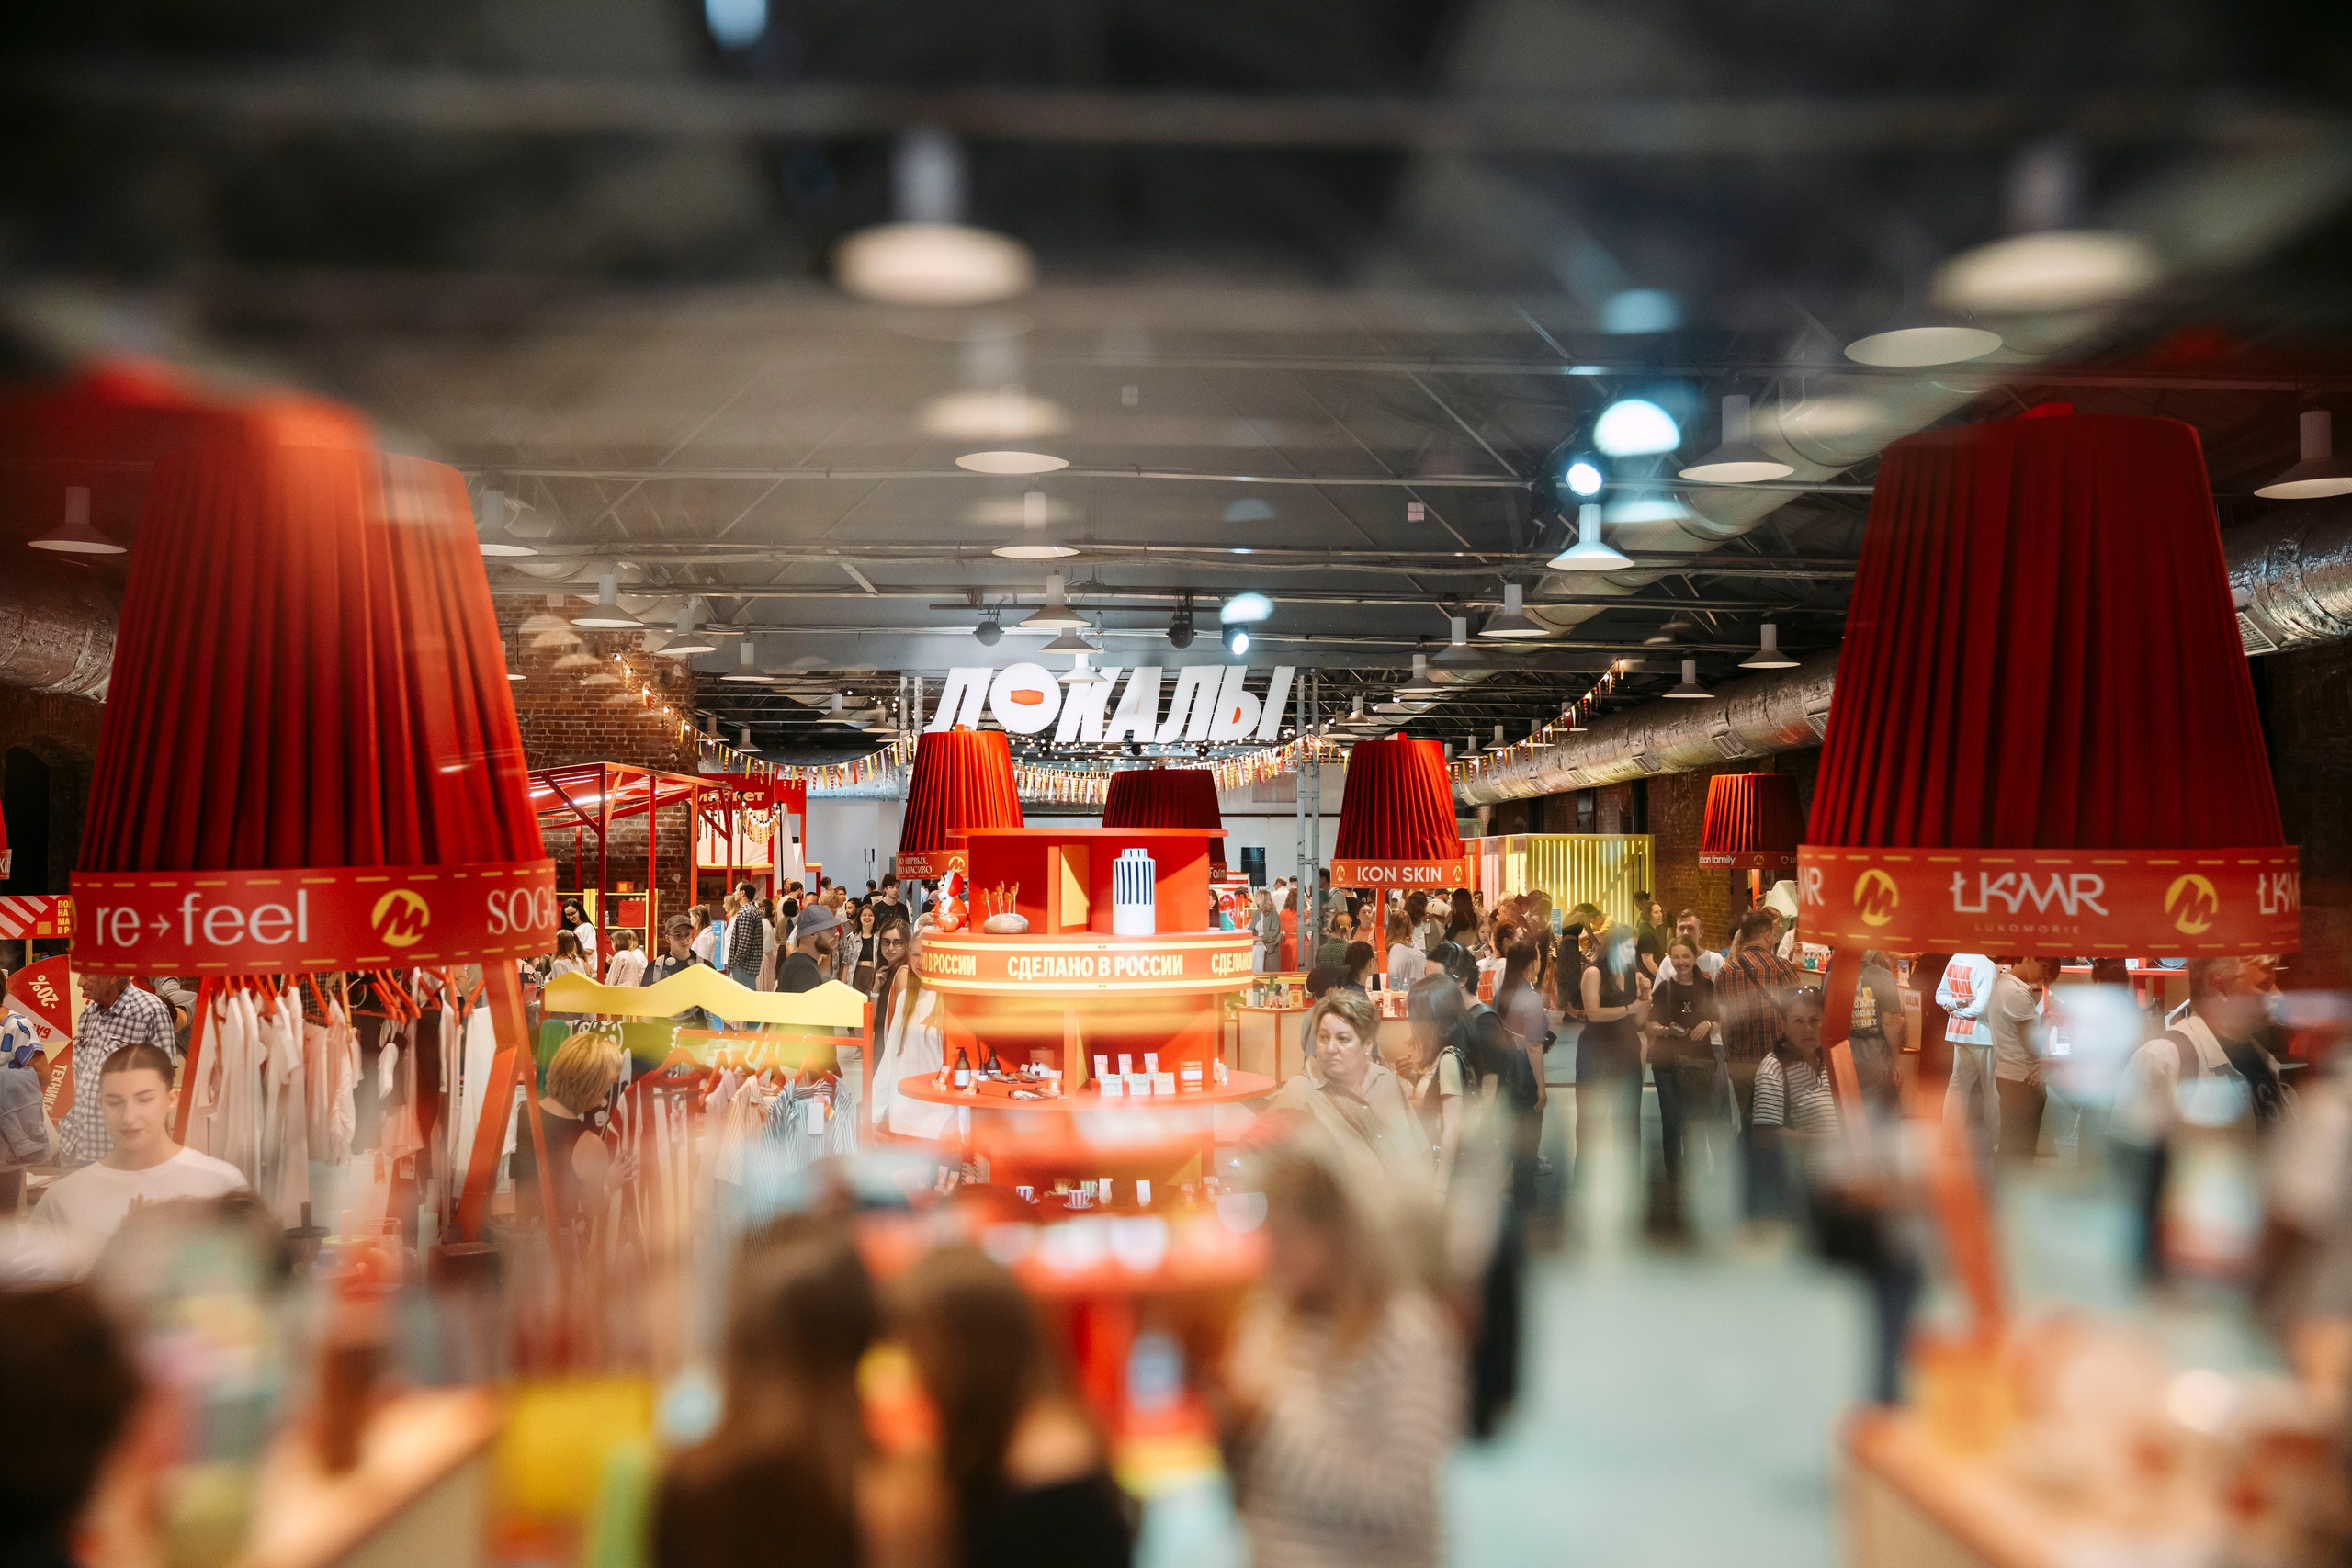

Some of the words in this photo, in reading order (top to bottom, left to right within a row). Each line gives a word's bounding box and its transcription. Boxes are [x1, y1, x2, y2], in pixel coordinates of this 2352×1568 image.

[924, 662, 1295, 743] ЛОКАЛЫ
[1712, 855, 1736, 865] family
[1357, 866, 1396, 882] ICON
[1402, 866, 1442, 883] SKIN
[177, 889, 307, 946] feel
[1974, 922, 2080, 934] LUKOMORIE
[933, 953, 977, 976] РОССИИ
[1007, 955, 1093, 980] СДЕЛАНО
[1098, 956, 1110, 976] В
[1114, 955, 1183, 976] РОССИИ
[28, 975, 60, 1010] -20%
[1854, 998, 1876, 1009] ODAY
[33, 1023, 51, 1039] БА
